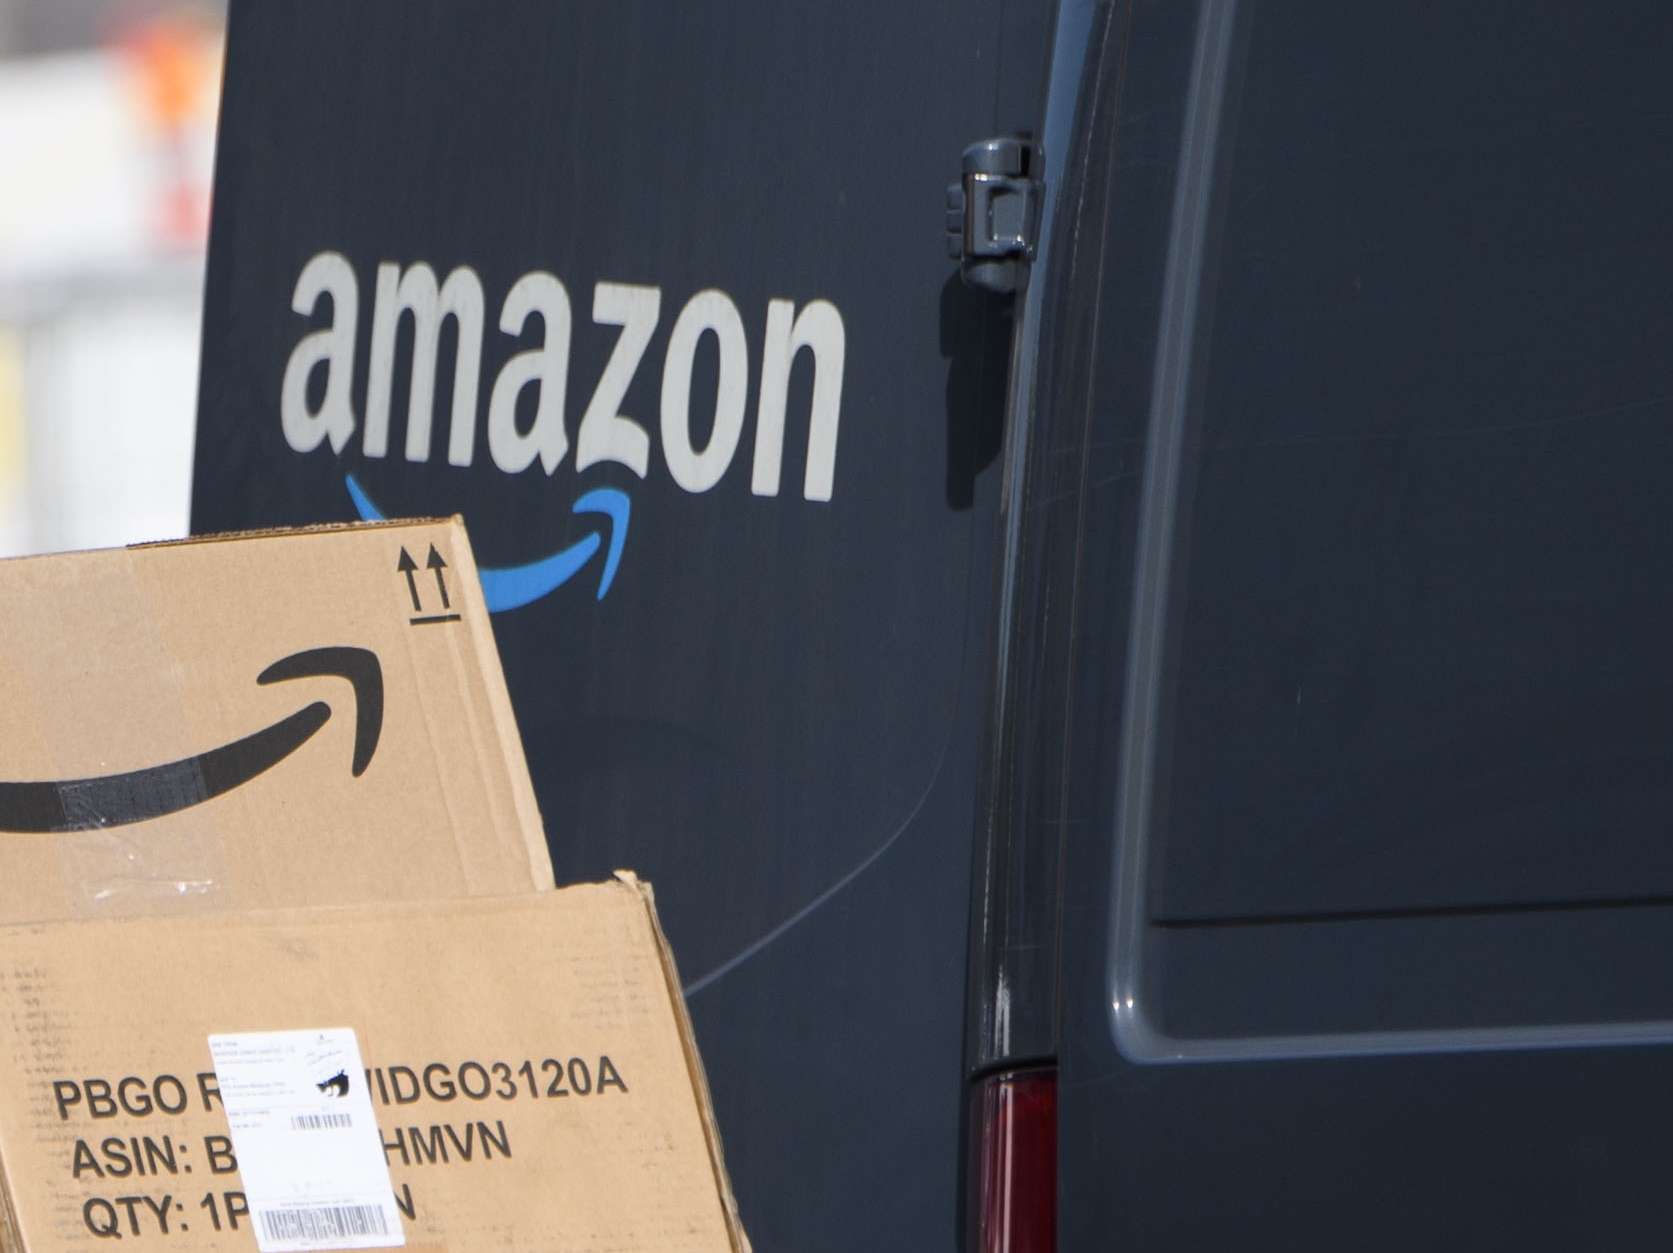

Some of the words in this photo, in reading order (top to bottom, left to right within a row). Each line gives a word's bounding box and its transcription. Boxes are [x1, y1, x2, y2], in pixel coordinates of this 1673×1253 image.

[281, 251, 846, 502] amazon
[52, 1074, 188, 1121] PBGO
[72, 1135, 193, 1179] ASIN:
[82, 1194, 191, 1239] QTY:
